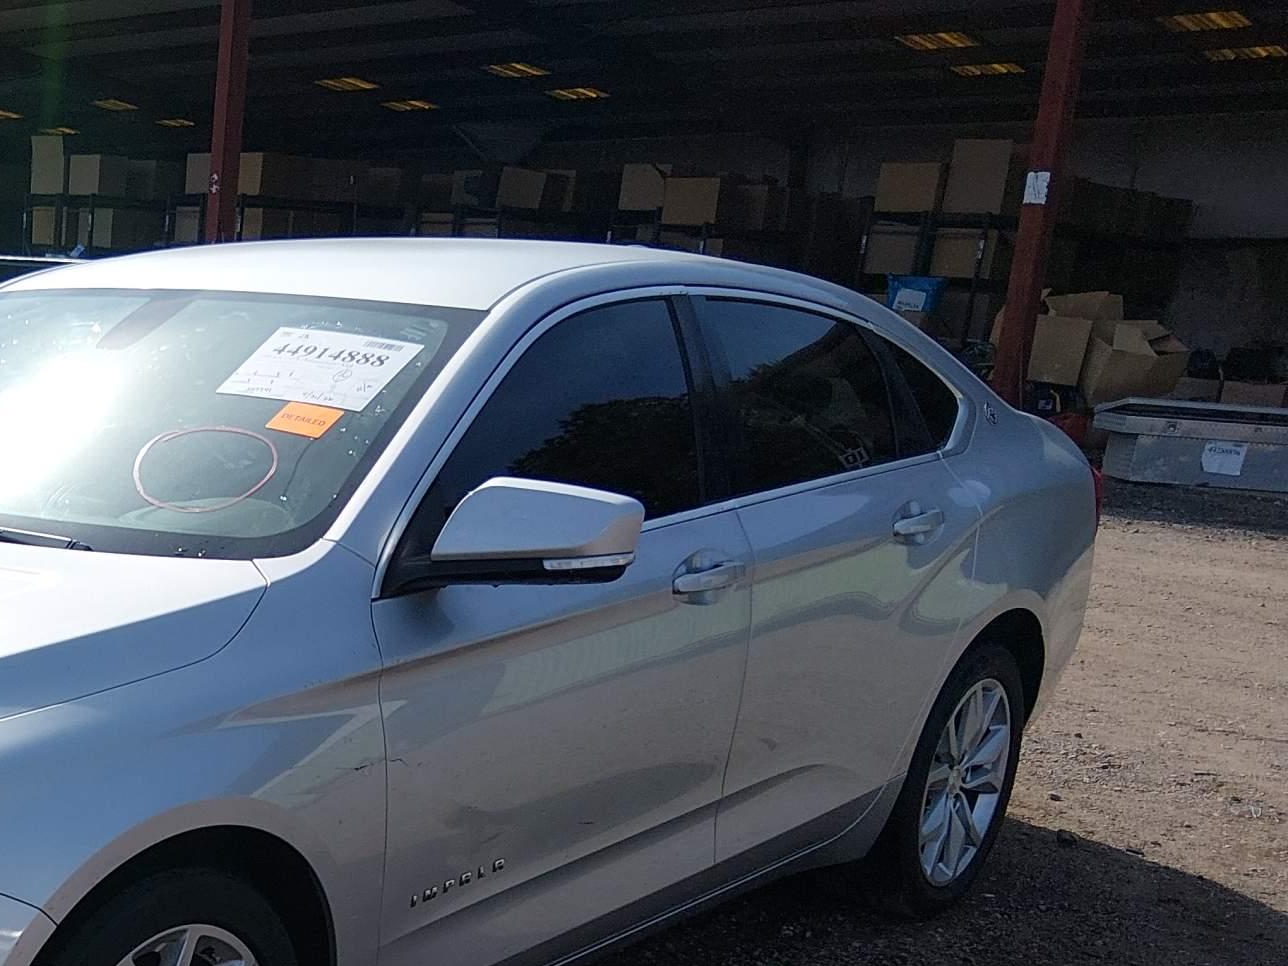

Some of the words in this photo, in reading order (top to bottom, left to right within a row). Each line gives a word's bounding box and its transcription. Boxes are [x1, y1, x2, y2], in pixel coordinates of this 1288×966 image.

[273, 343, 390, 367] 44914888
[281, 412, 326, 427] DETAILED
[410, 858, 505, 908] IMPALA
